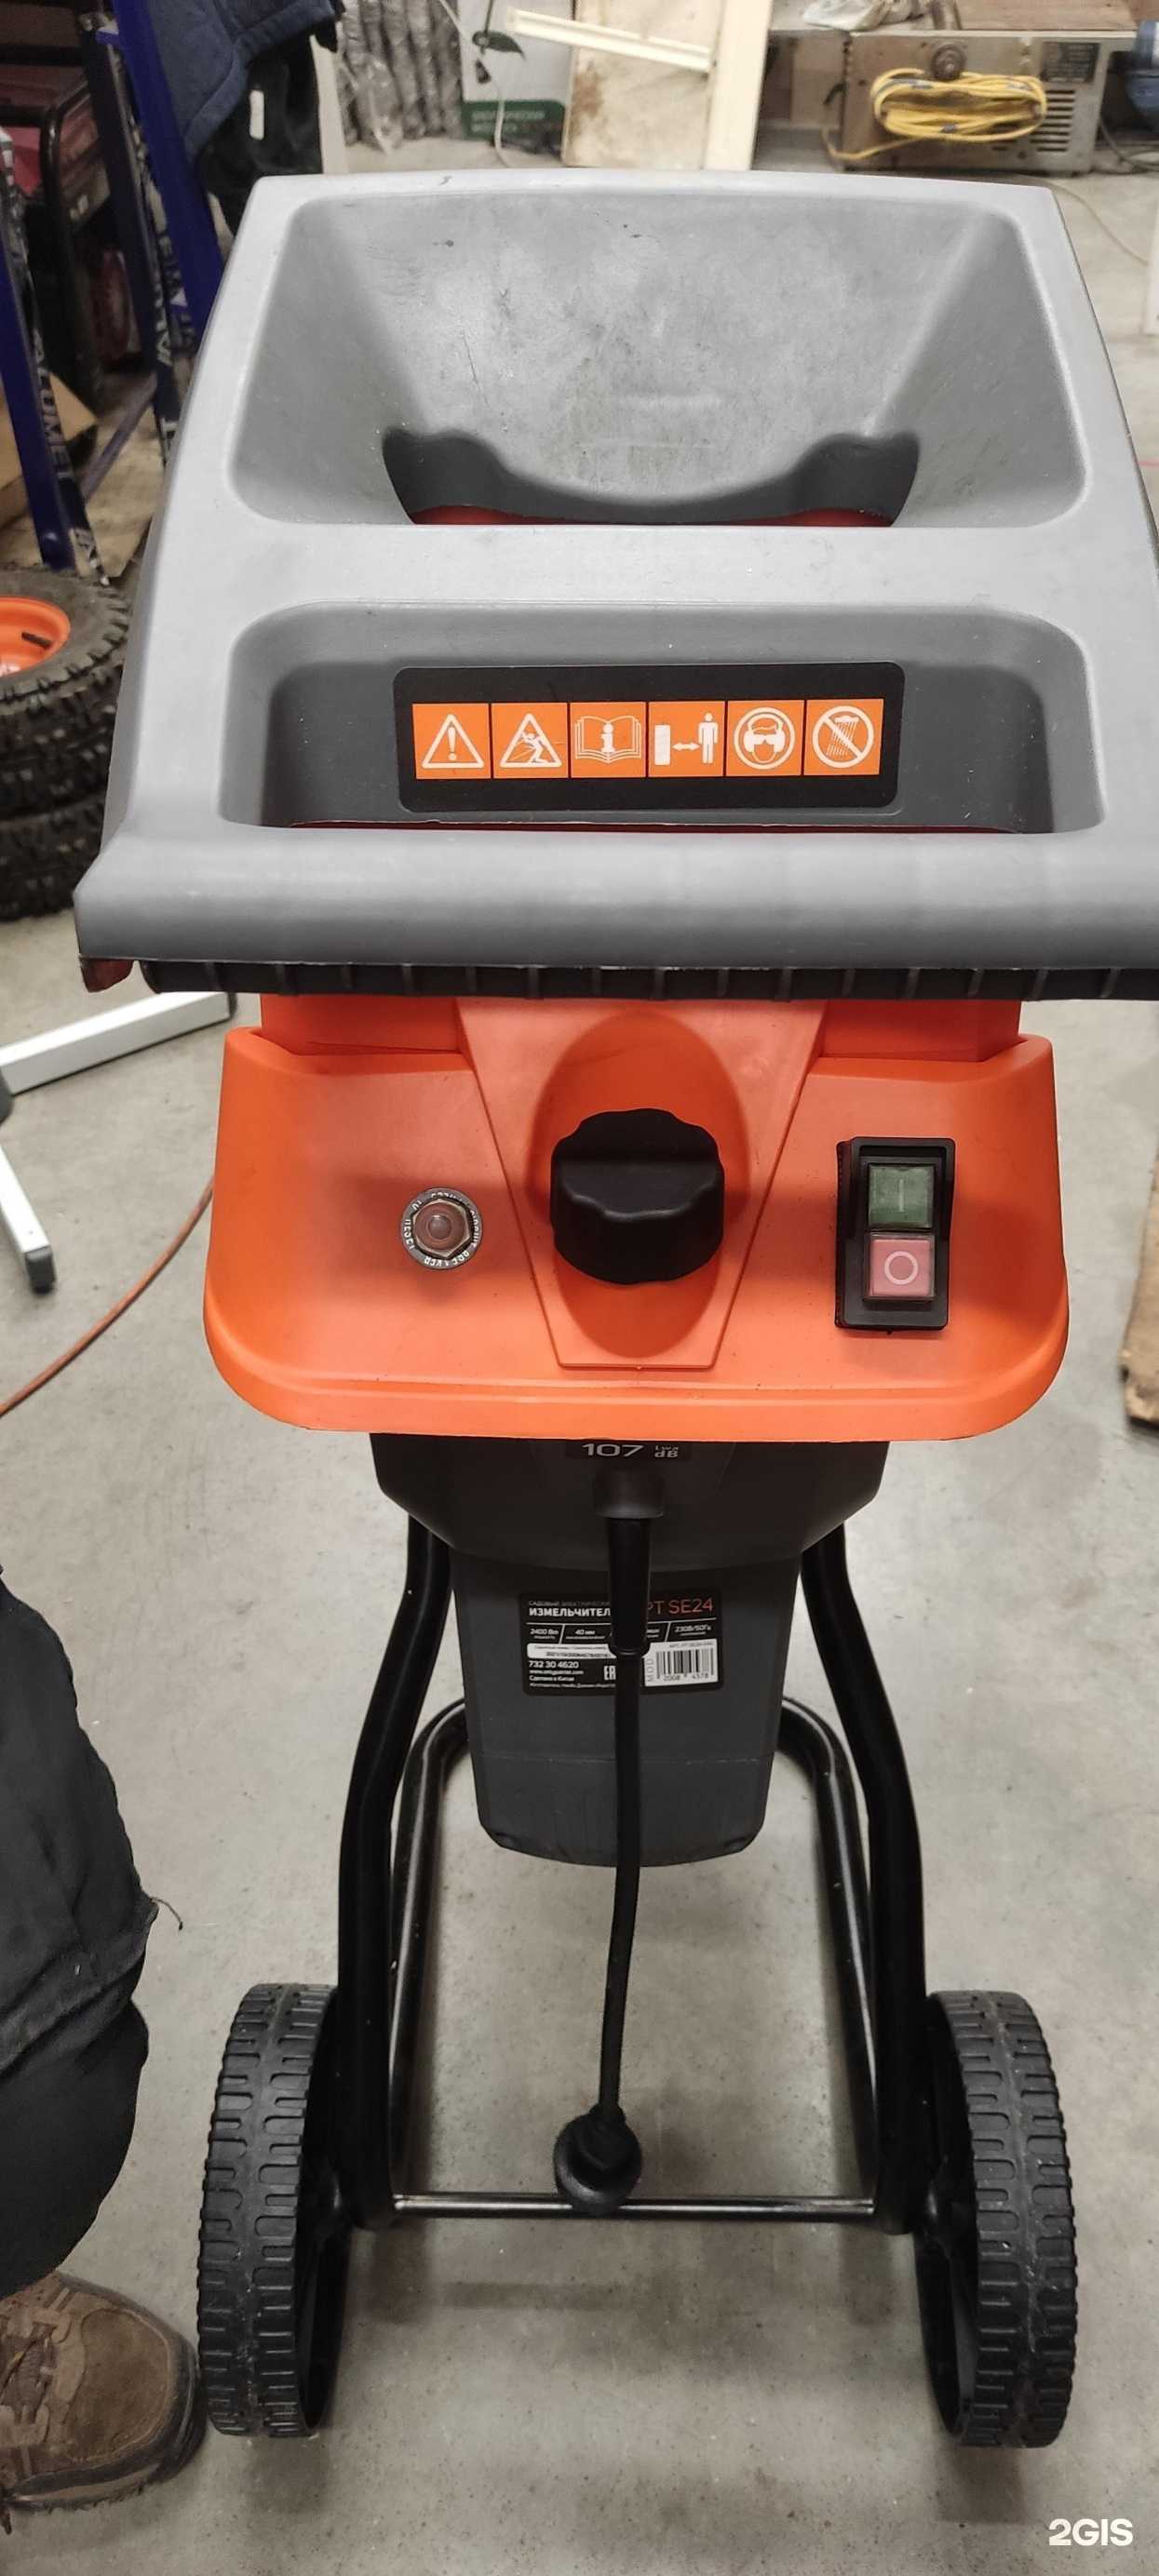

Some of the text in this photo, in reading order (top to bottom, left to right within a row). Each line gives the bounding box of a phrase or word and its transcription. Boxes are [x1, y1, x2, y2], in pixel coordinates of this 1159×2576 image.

[582, 1443, 645, 1457] 107
[528, 1607, 612, 1617] ИЗМЕЛЬЧИТЕЛ
[668, 1597, 713, 1615] SE24
[528, 1660, 545, 1669] 732
[546, 1660, 557, 1669] 30
